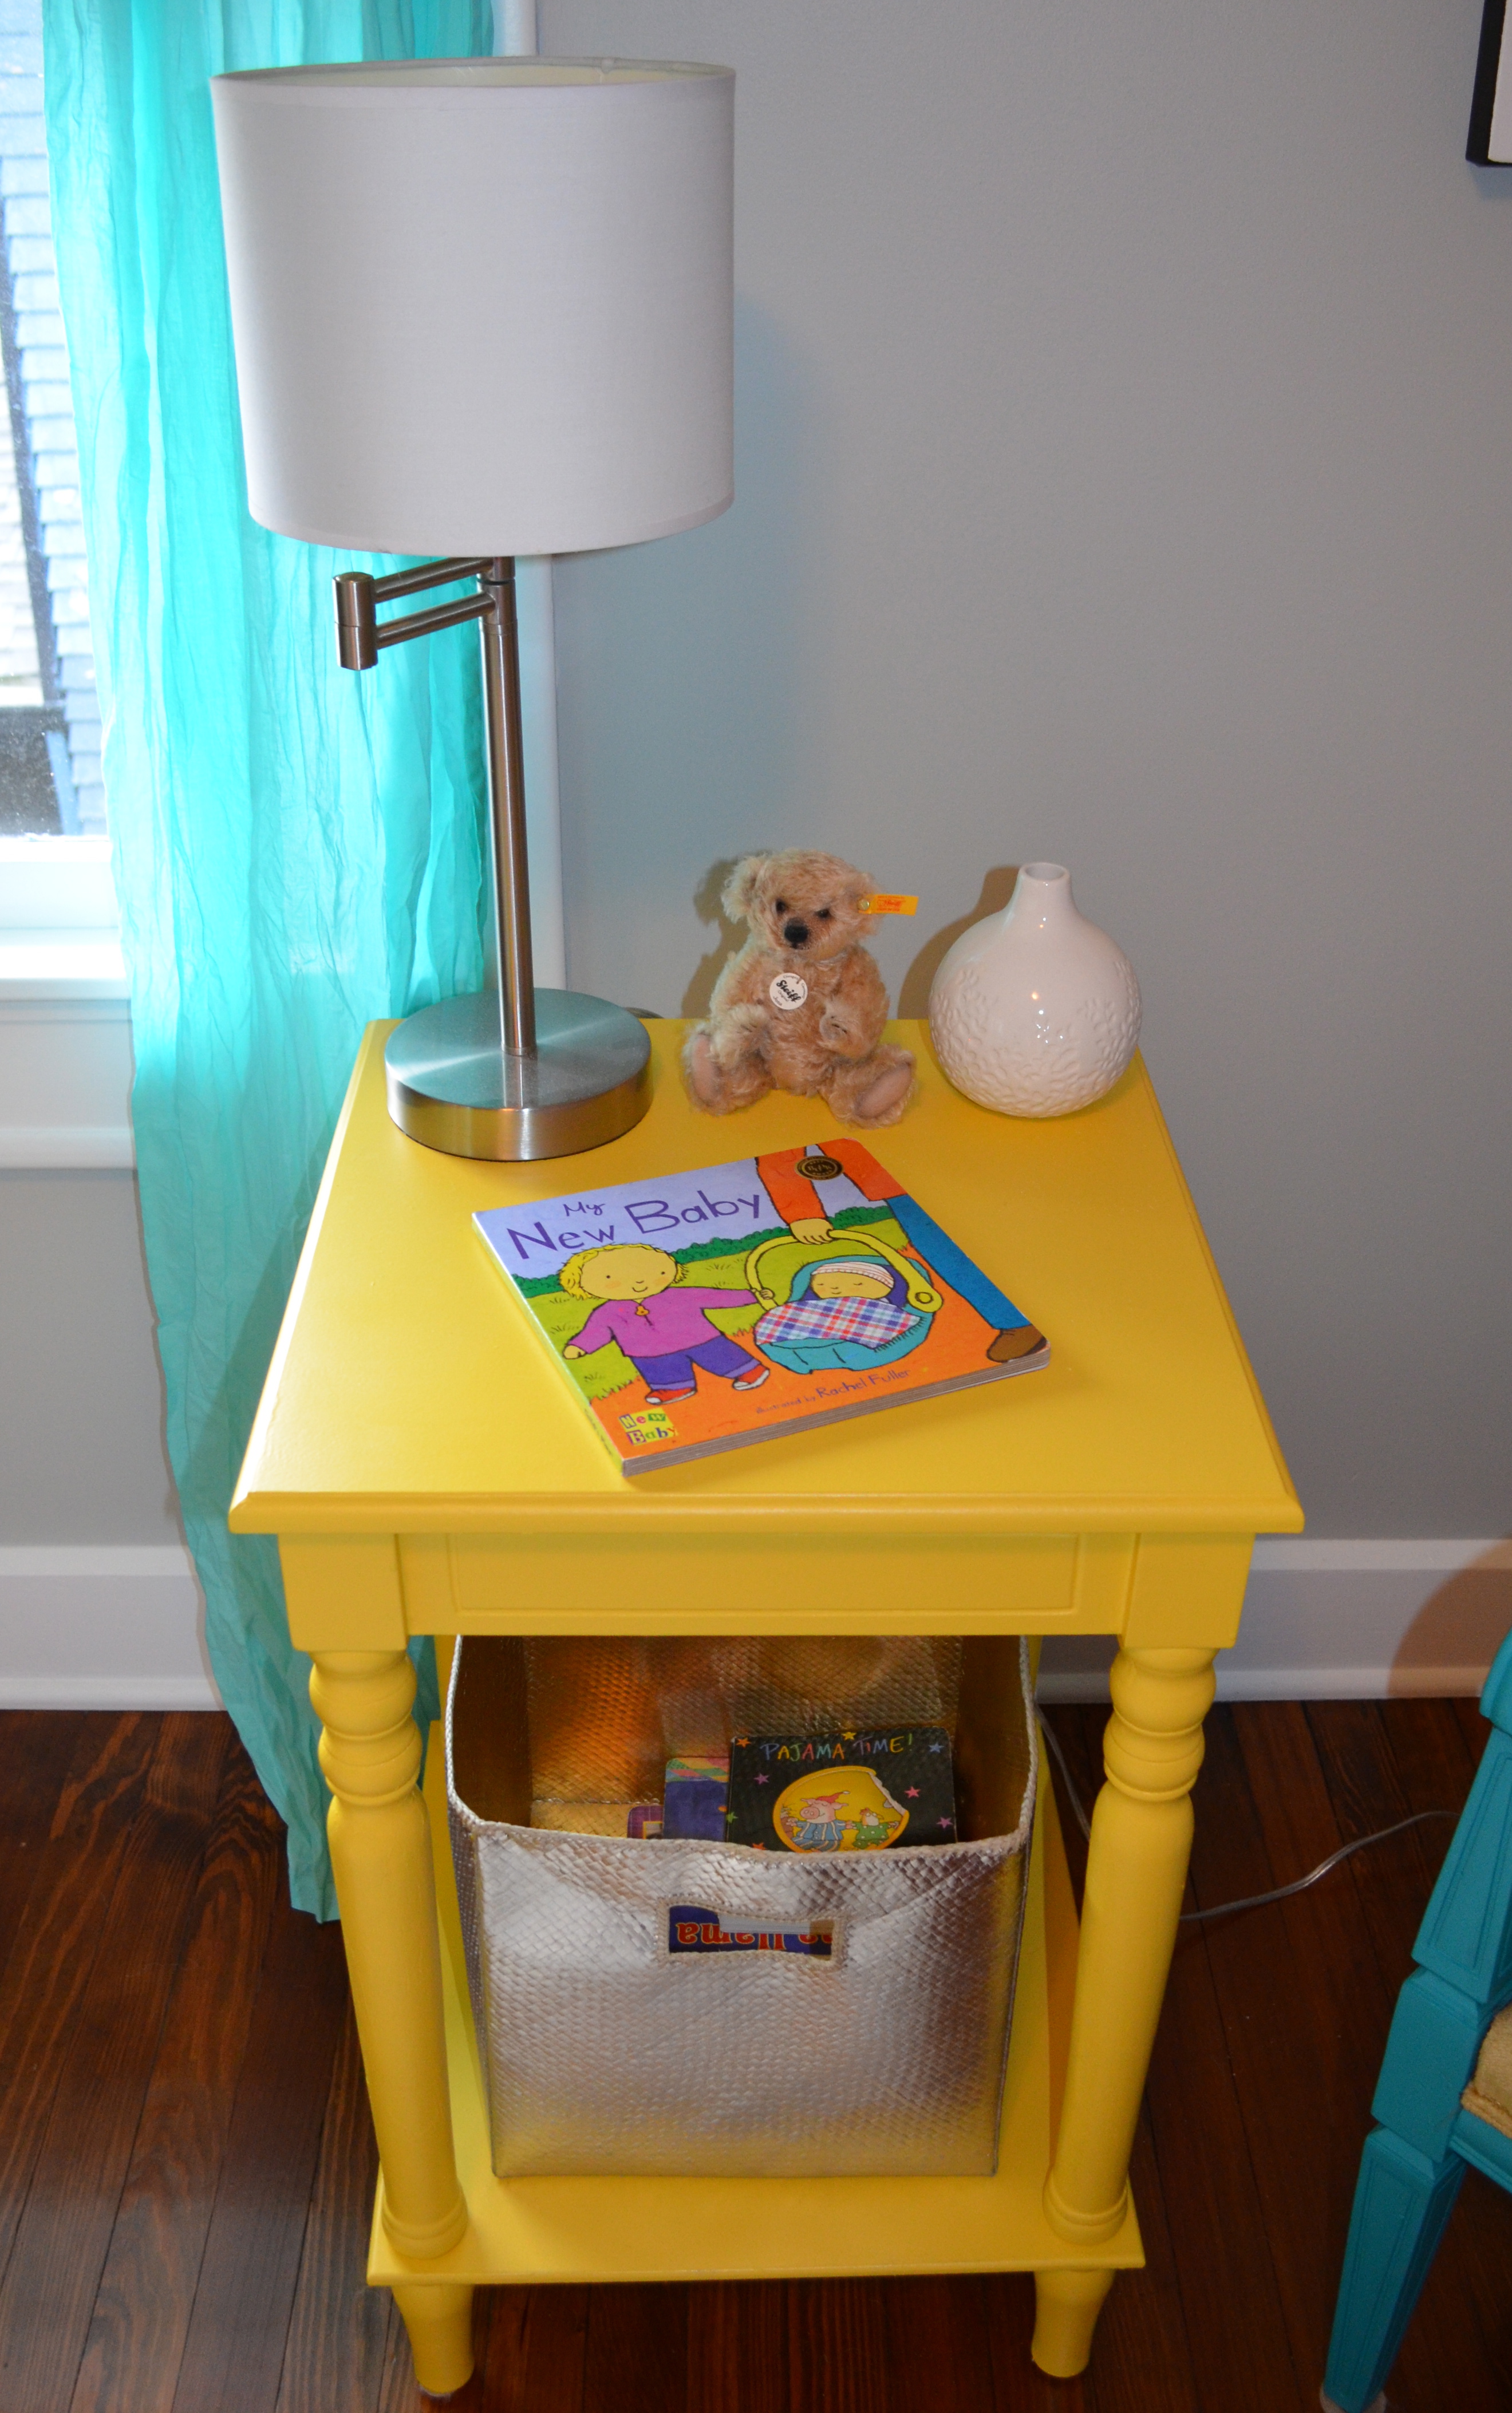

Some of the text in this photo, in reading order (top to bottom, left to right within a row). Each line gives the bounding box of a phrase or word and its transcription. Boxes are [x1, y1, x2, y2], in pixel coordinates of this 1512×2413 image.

[776, 980, 802, 1002] Steiff
[563, 1201, 606, 1217] My
[507, 1190, 760, 1259] New Baby
[815, 1378, 867, 1398] Rachel
[868, 1369, 911, 1385] Fuller
[618, 1413, 666, 1429] New
[626, 1425, 676, 1446] Baby
[760, 1742, 845, 1762] PAJAMA
